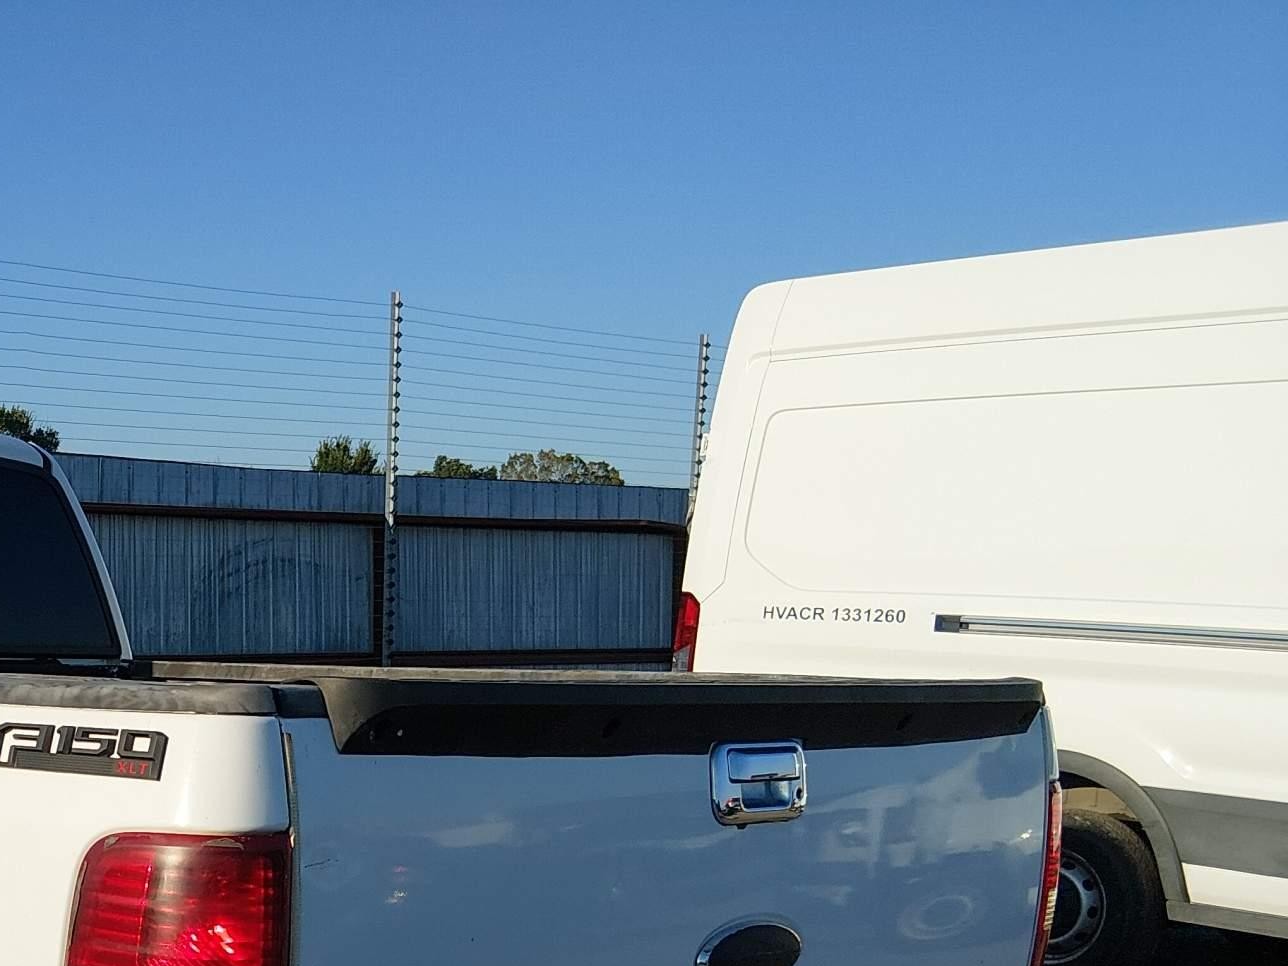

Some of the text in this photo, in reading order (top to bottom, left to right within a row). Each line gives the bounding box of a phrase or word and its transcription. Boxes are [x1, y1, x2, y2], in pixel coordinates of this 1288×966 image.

[762, 605, 906, 624] HVACR 1331260
[116, 760, 150, 777] XLT
